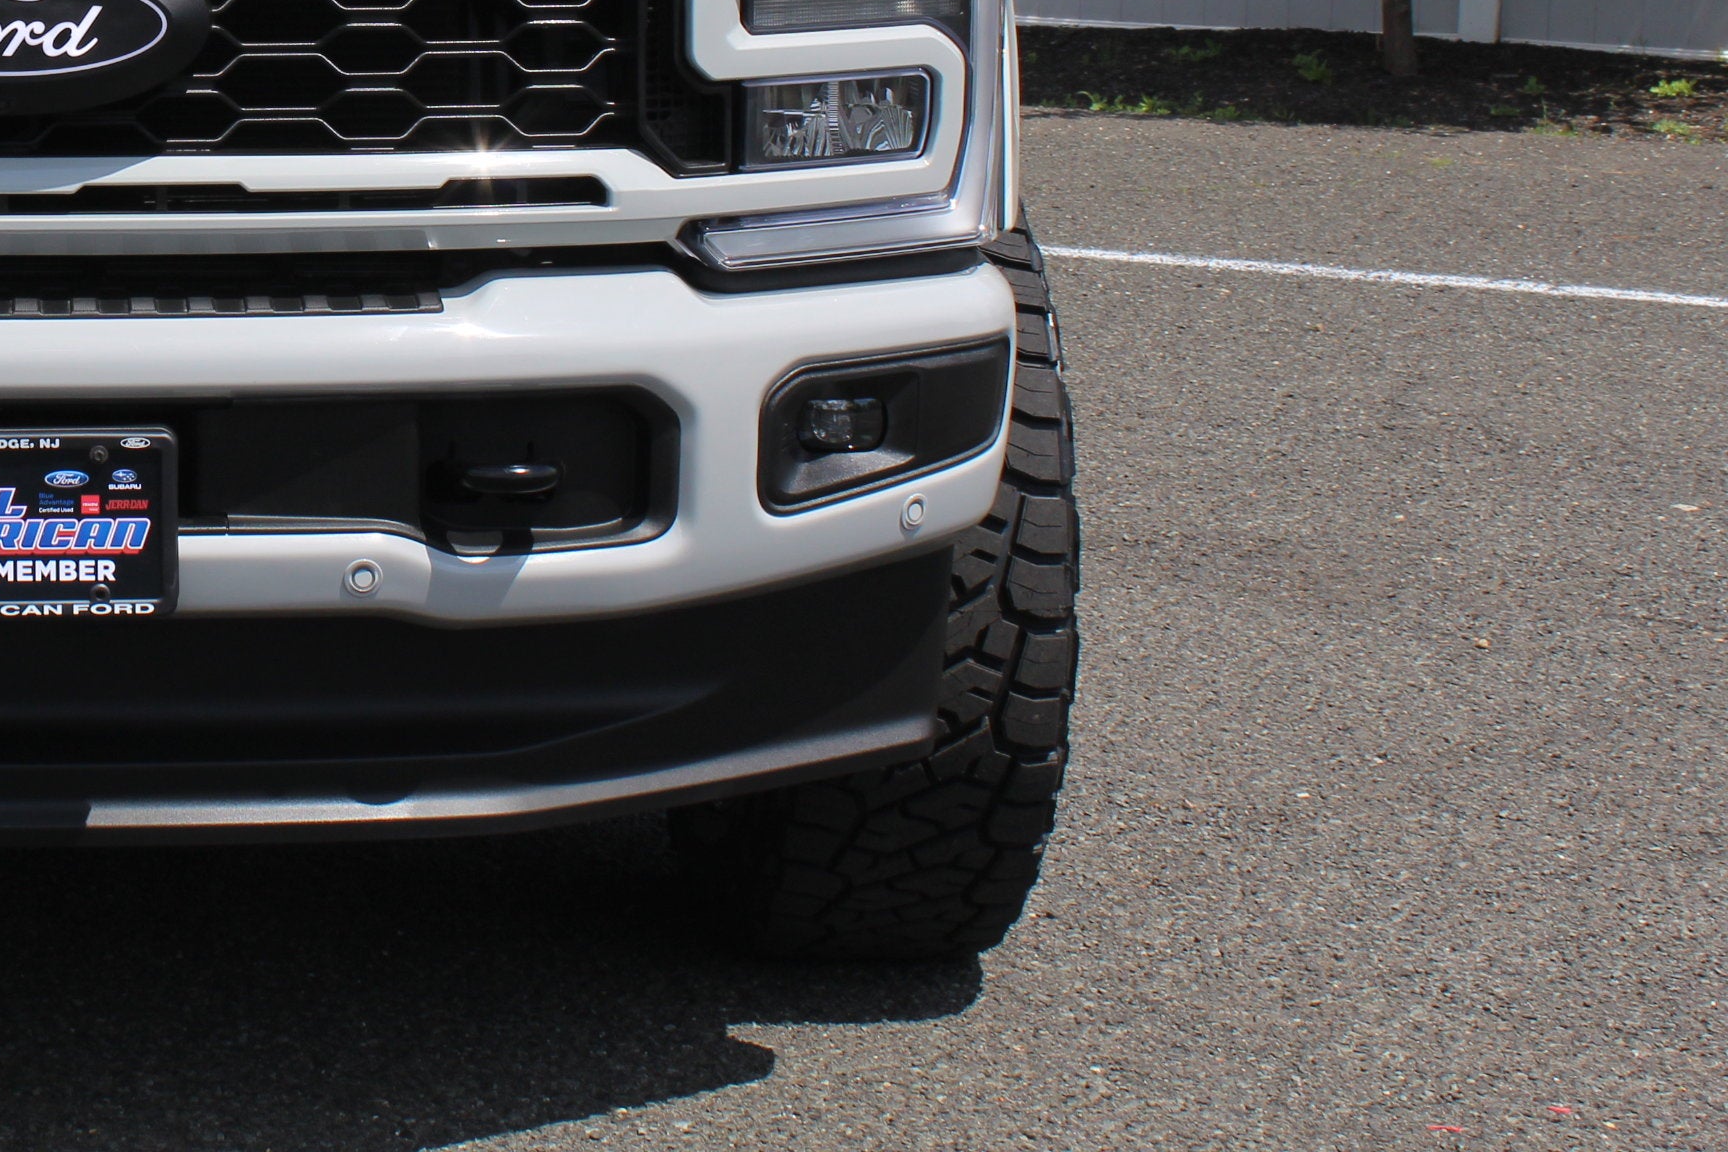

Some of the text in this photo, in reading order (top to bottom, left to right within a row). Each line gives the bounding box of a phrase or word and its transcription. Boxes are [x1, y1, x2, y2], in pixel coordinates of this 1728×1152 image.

[39, 438, 60, 449] NJ
[52, 473, 81, 485] Ford
[73, 603, 155, 616] FORD
